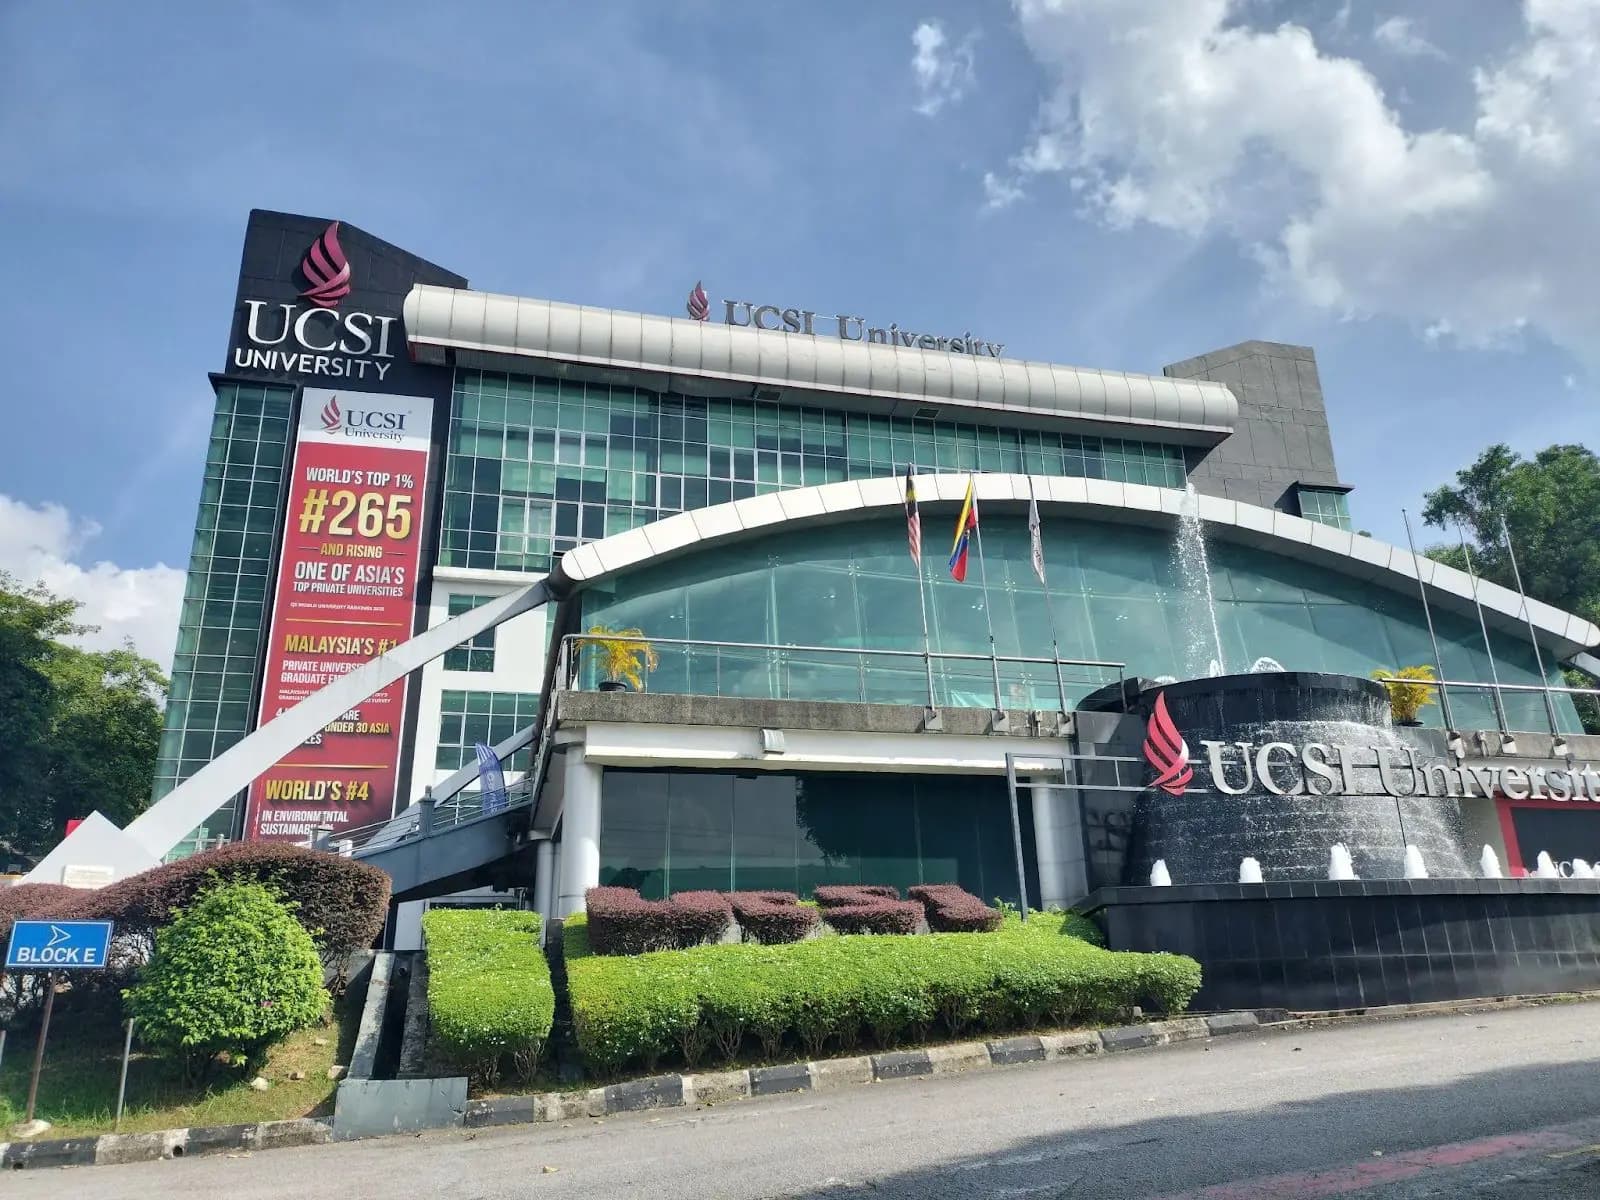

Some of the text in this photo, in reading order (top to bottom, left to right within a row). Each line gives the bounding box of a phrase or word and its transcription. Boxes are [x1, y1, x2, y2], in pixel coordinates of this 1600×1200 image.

[244, 299, 399, 358] UCSI
[722, 299, 1005, 359] UCSI University
[234, 347, 392, 381] UNIVERSITY
[345, 409, 407, 430] UCSI
[344, 427, 406, 443] University
[306, 466, 414, 489] WORLD'S TOP 1%
[299, 488, 412, 540] #265
[320, 543, 383, 559] AND RISING
[294, 561, 405, 585] ONE OF ASIA'S
[293, 581, 404, 597] TOP PRIVATE UNIVERSITIES
[285, 634, 374, 656] MALAYSIA'S
[282, 660, 319, 672] PRIVATE
[281, 672, 327, 685] GRADUATE
[324, 721, 390, 734] UNDER 30 ASIA
[1199, 739, 1600, 802] UCSI Universit
[265, 779, 370, 801] WORLD'S #4
[262, 810, 272, 822] IN
[17, 948, 96, 962] BLOCK E
